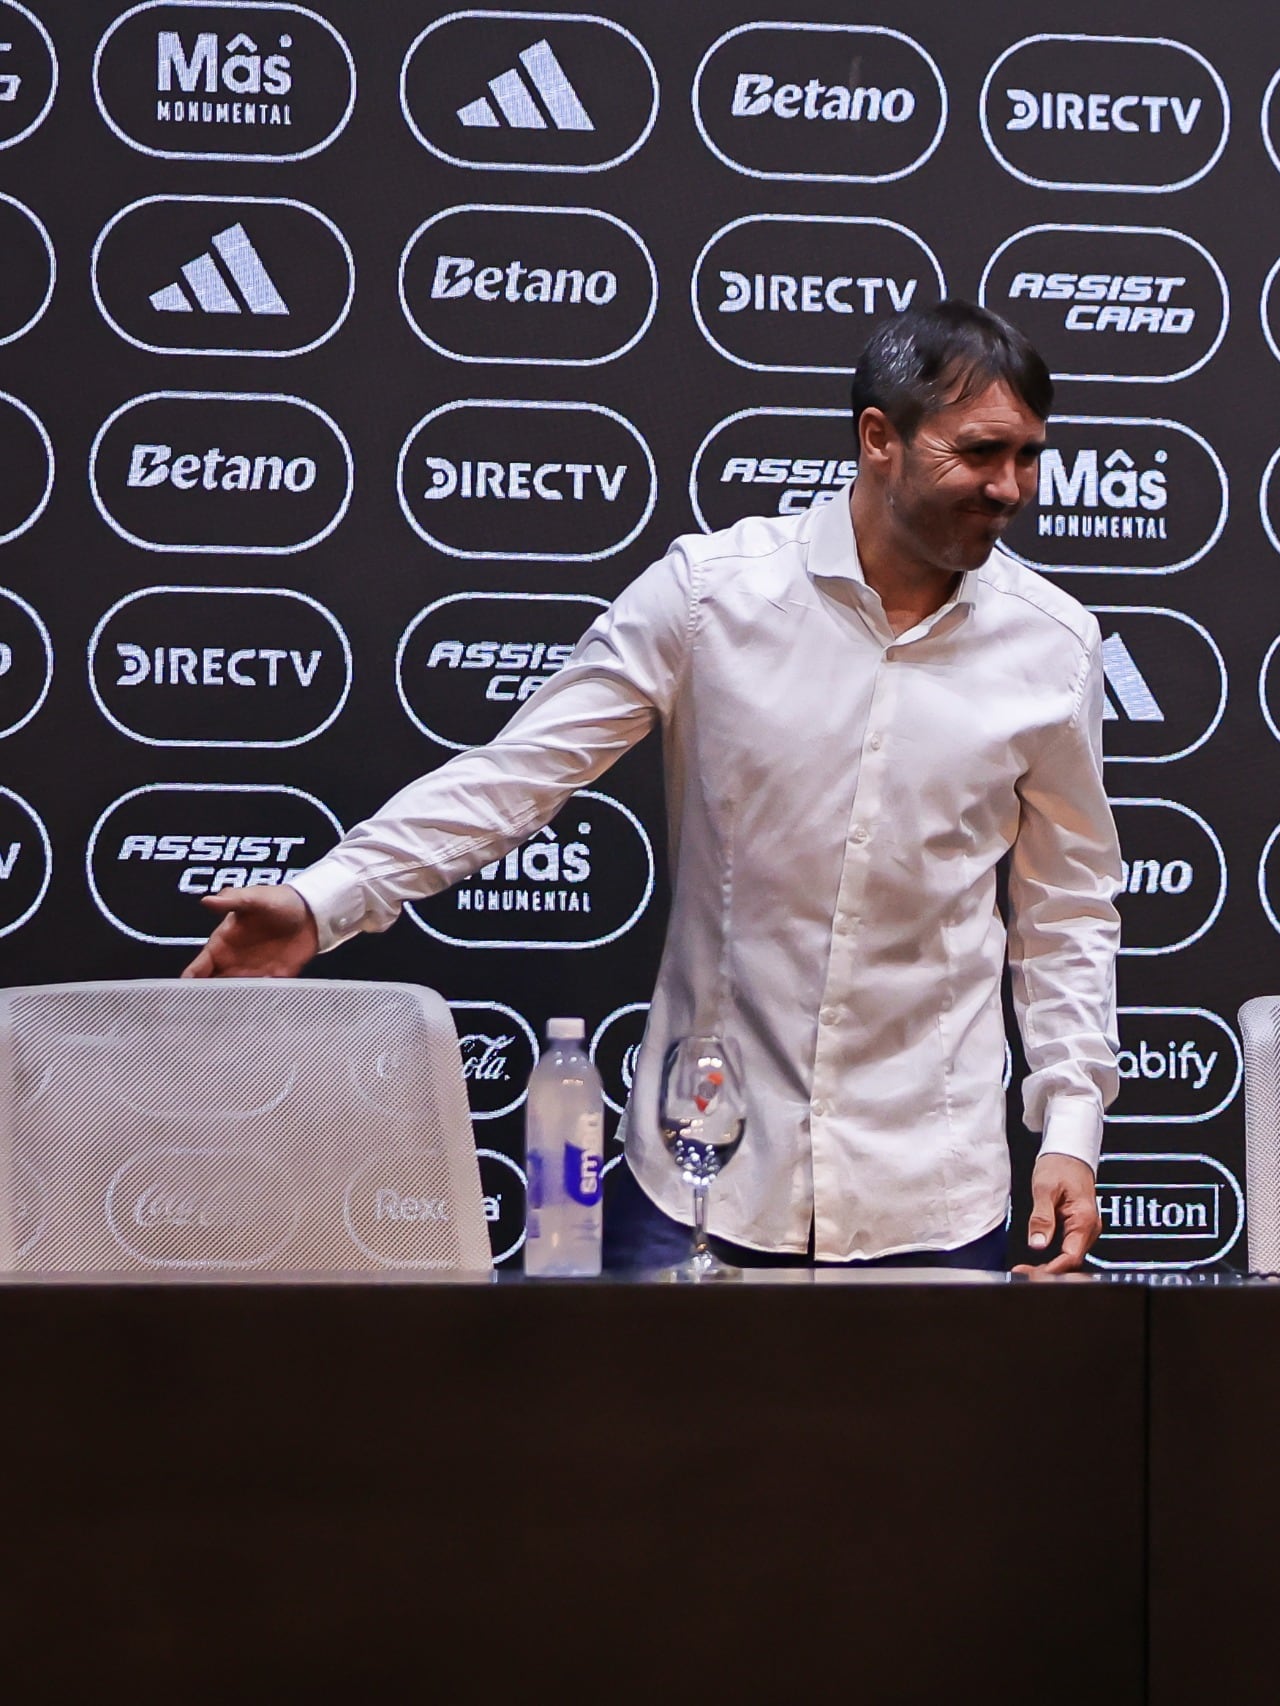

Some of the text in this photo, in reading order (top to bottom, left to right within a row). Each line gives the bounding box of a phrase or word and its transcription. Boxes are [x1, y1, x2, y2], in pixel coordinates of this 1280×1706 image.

[158, 100, 291, 125] MONUMENTAL
[732, 74, 914, 122] Betano
[1007, 89, 1201, 134] DIRECTV
[431, 256, 616, 305] Betano
[719, 271, 917, 313] DIRECTV
[1009, 273, 1185, 302] ASSIST
[1066, 305, 1195, 333] CARD
[127, 445, 316, 492] Betano
[424, 457, 627, 501] DIRECTV
[1039, 515, 1166, 538] MONUMENTAL
[117, 644, 321, 686] DIRECTV
[427, 640, 575, 670] ASSIS
[486, 675, 549, 701] CA
[118, 836, 305, 861] ASSIST
[178, 867, 305, 895] CAR
[458, 890, 590, 912] MONUMENTAL
[1117, 1041, 1218, 1089] abify
[1097, 1196, 1207, 1227] Hilton
